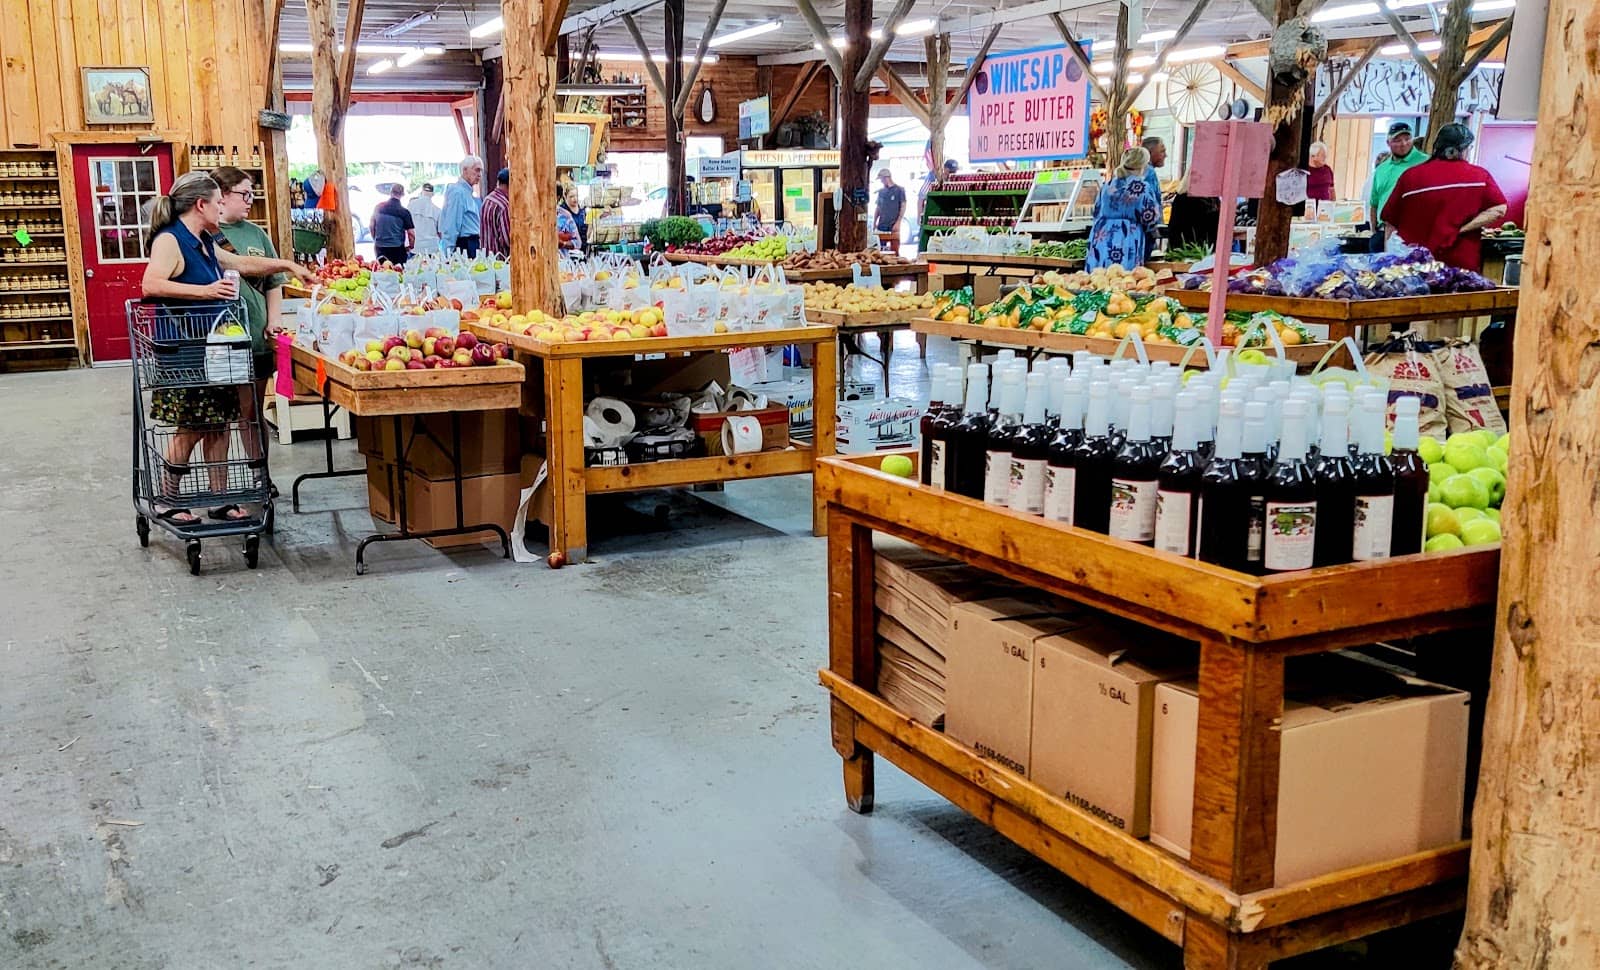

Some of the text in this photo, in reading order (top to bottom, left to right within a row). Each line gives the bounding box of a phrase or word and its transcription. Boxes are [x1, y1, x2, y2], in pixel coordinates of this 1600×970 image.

[990, 53, 1064, 95] WINESAP
[980, 95, 1074, 127] APPLE BUTTER
[977, 130, 1075, 153] NO PRESERVATIVES
[754, 152, 784, 163] FRESH
[786, 152, 815, 163] APPLE
[1162, 703, 1168, 715] 6
